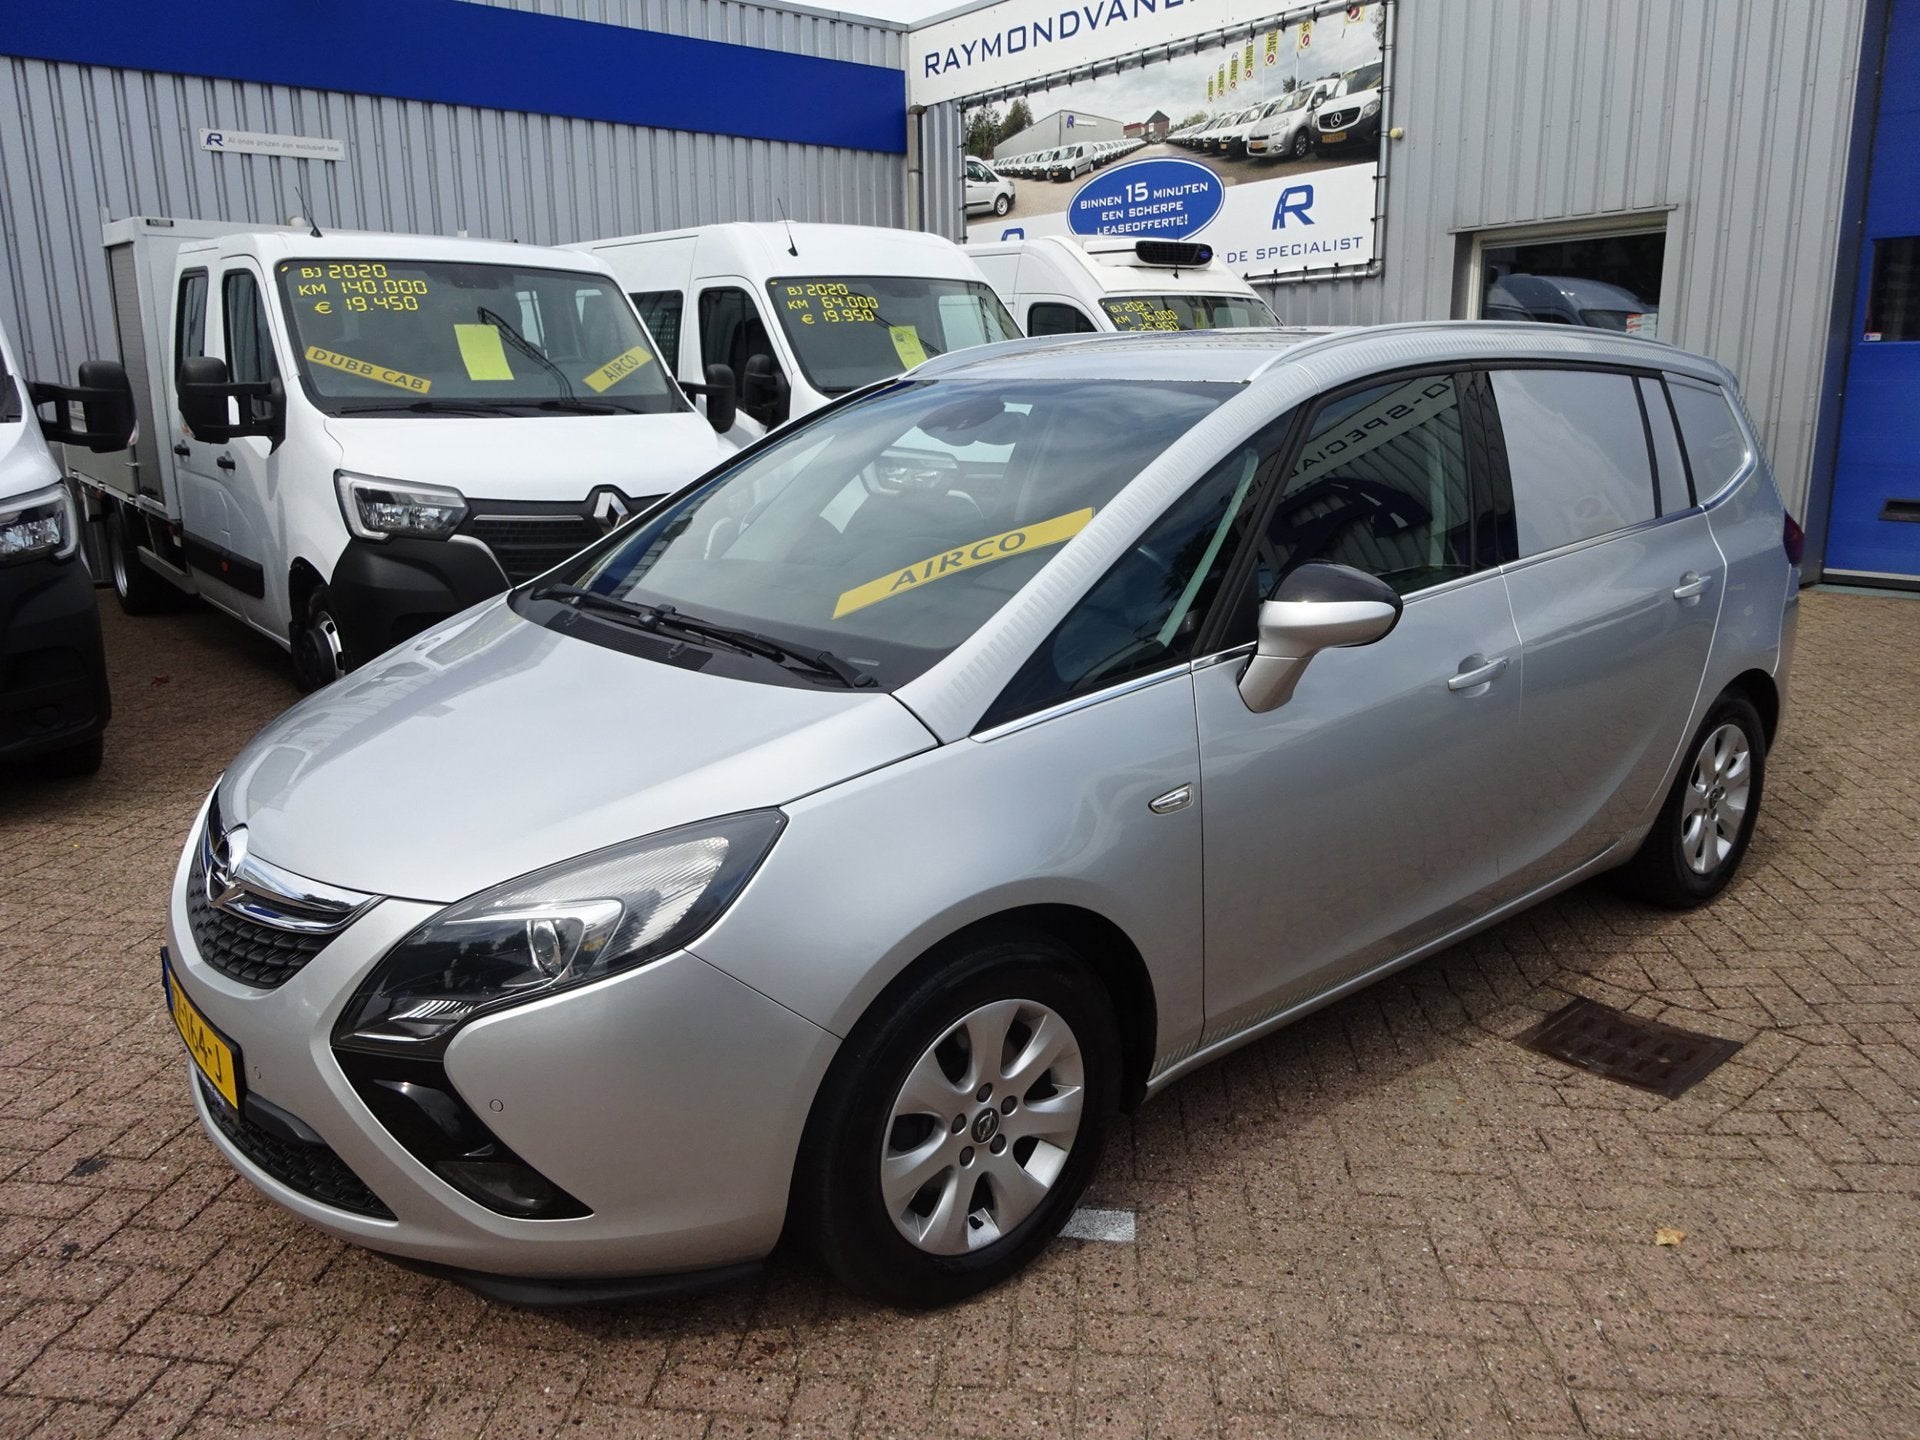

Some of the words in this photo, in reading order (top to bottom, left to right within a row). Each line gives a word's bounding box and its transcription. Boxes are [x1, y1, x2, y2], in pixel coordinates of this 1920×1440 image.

[925, 0, 1194, 78] RAYMONDVAN
[1080, 196, 1122, 209] BINNEN
[1125, 182, 1149, 203] 15
[1153, 182, 1209, 199] MINUTEN
[1102, 210, 1124, 221] EEN
[1128, 201, 1184, 218] SCHERPE
[1097, 214, 1188, 235] LEASEOFFERTE!
[1227, 250, 1248, 264] DE
[1256, 236, 1364, 261] SPECIALIST
[301, 267, 322, 279] BJ
[328, 264, 388, 279] 2020
[298, 283, 327, 296] KM
[341, 279, 428, 295] 140.000
[787, 286, 803, 296] BJ
[806, 283, 849, 296] 2020
[314, 301, 332, 314] €
[346, 296, 419, 312] 19.450
[787, 300, 808, 310] KM
[821, 296, 879, 309] 64.000
[801, 313, 815, 325] €
[823, 309, 875, 322] 19.950
[1114, 315, 1131, 324] KM
[312, 349, 374, 375] DUBB
[382, 371, 424, 390] CAB
[602, 354, 639, 382] AIRCO
[889, 532, 1027, 592] AIRCO
